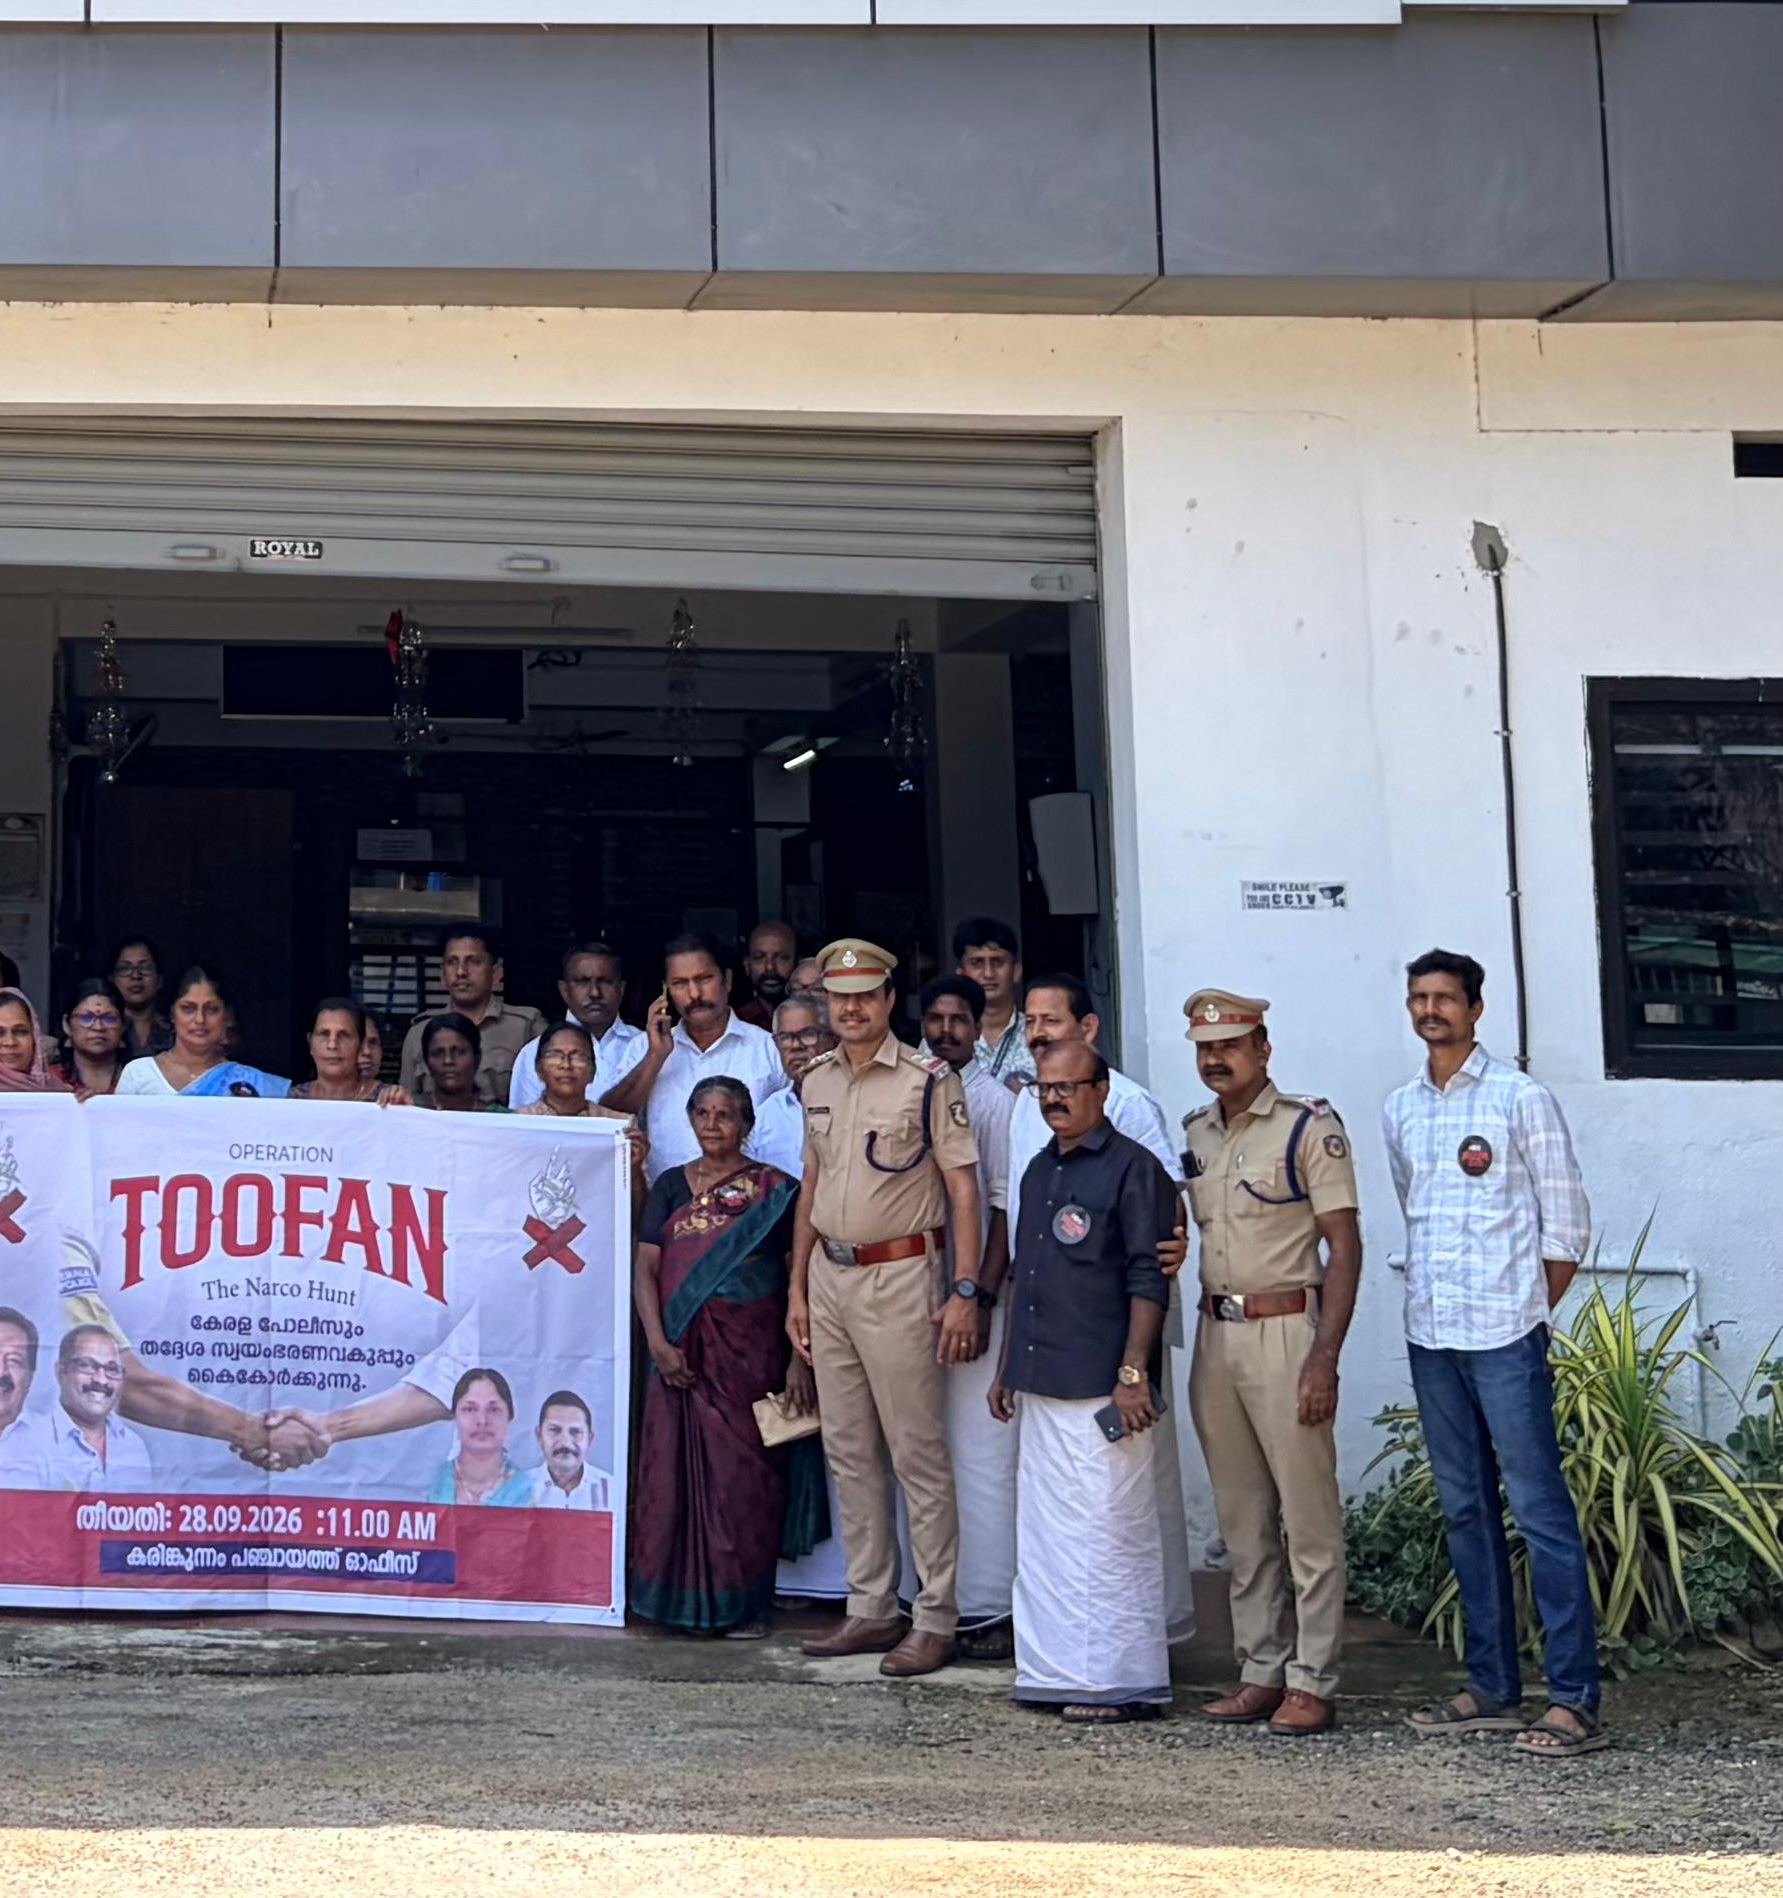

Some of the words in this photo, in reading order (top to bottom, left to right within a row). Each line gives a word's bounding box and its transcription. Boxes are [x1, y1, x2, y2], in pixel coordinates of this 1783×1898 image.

[253, 541, 319, 556] ROYAL
[1279, 883, 1311, 892] PLEASE
[1271, 893, 1316, 906] CCTV
[228, 1143, 334, 1163] OPERATION
[110, 1173, 449, 1306] TOOFAN
[201, 1280, 239, 1301] The
[245, 1276, 302, 1298] Narco
[308, 1280, 356, 1307] Hunt
[190, 1314, 253, 1336] കേരള
[258, 1315, 365, 1340] പോലീസും
[140, 1340, 205, 1361] തദ്ദേശ
[76, 1499, 172, 1532] തീയതി:
[178, 1504, 303, 1534] 28.09.2026
[396, 1510, 437, 1542] AM
[126, 1542, 227, 1572] കരിങ്കുന്നം
[231, 1546, 343, 1570] പഞ്ചായത്ത്
[345, 1549, 422, 1575] ഓഫീസ്
